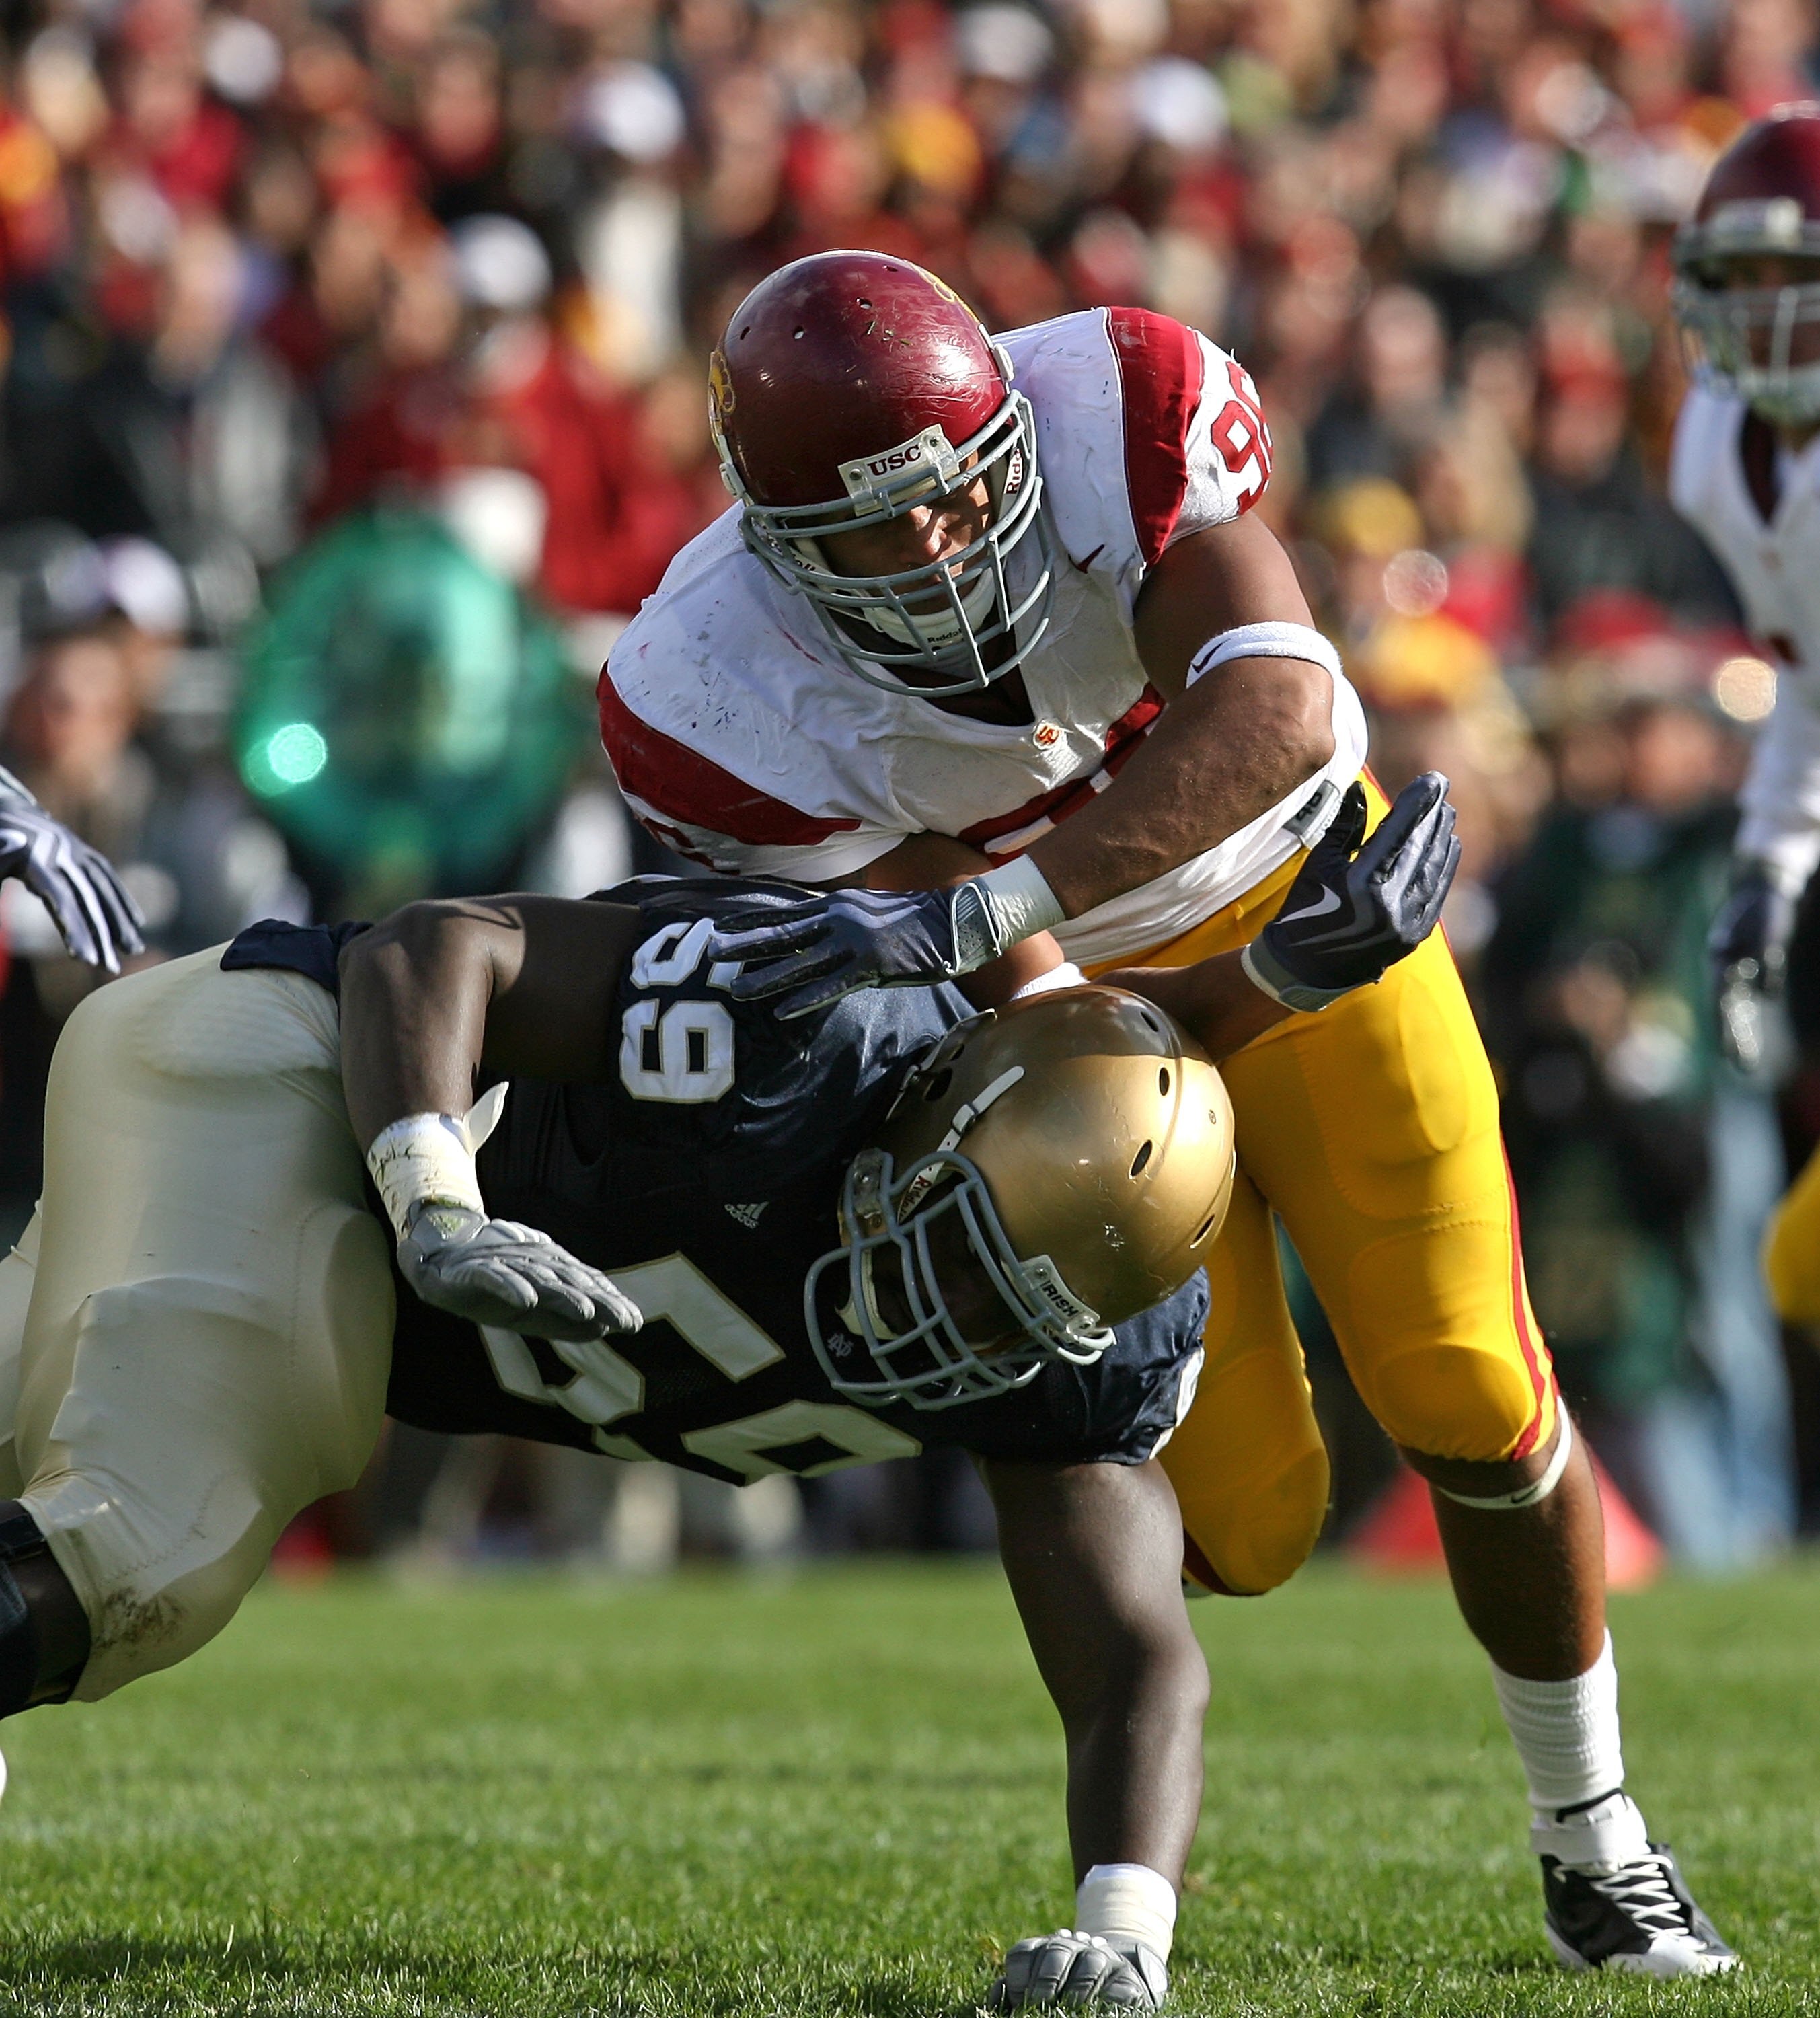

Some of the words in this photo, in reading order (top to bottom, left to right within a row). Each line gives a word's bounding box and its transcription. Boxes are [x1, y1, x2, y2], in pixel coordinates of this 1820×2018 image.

[867, 445, 921, 476] USC
[724, 1203, 759, 1229] adidas
[1040, 1280, 1079, 1317] IRISH
